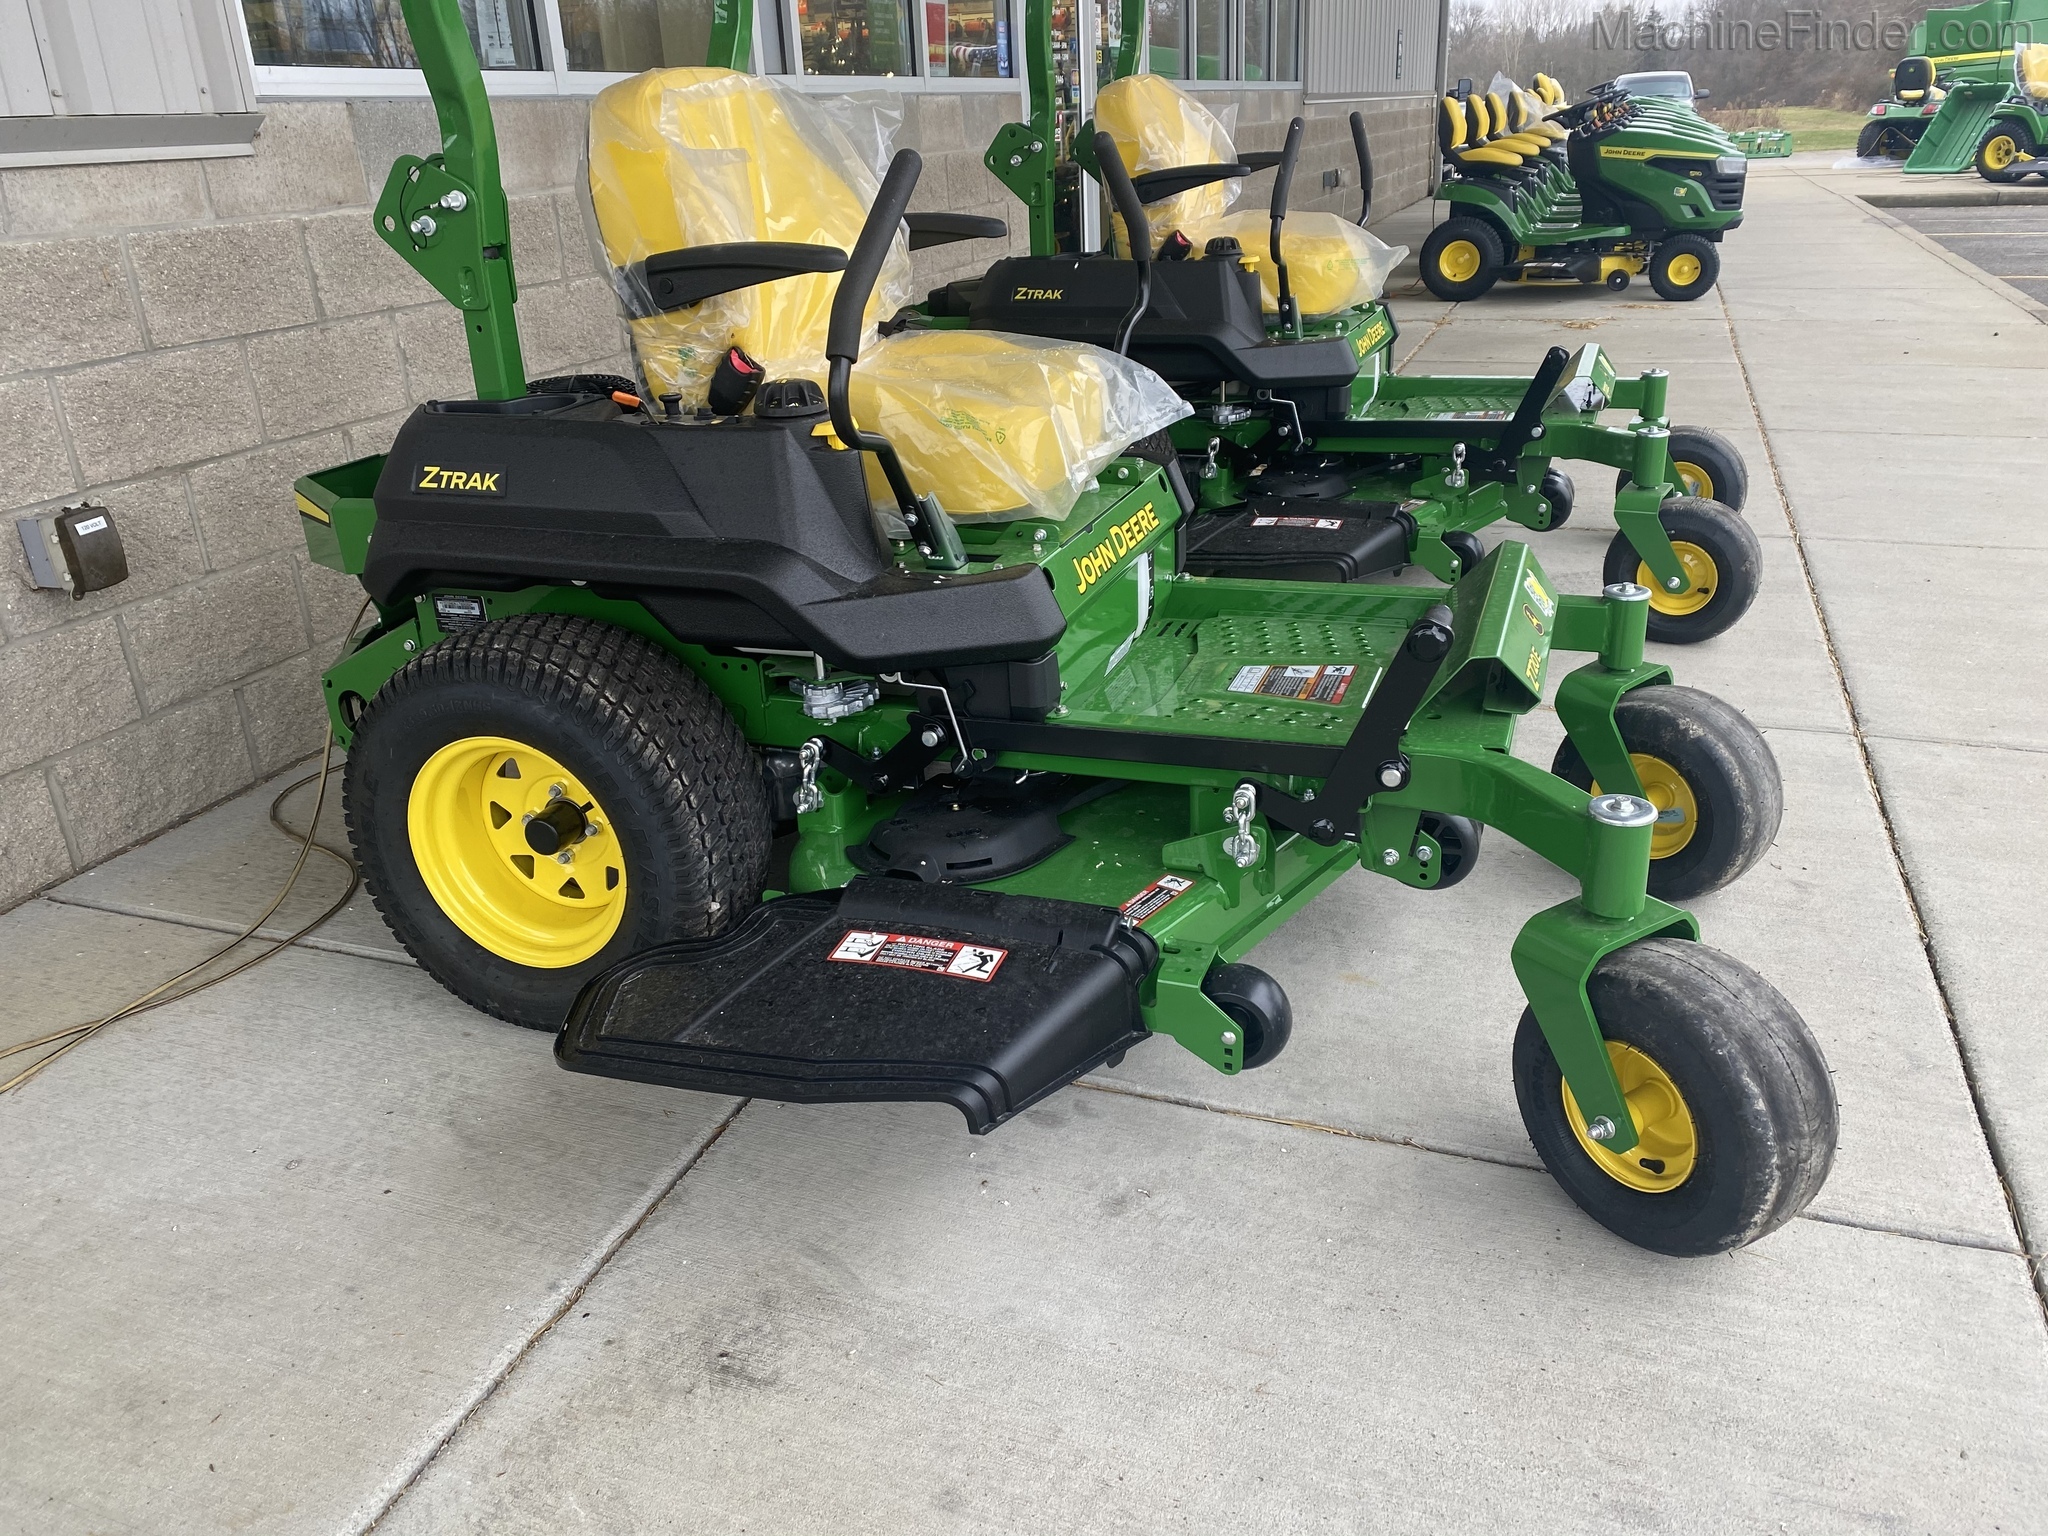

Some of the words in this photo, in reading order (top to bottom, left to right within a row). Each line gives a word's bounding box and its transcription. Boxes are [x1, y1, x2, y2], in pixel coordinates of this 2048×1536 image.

[1623, 149, 1646, 157] DEERE
[1014, 287, 1064, 300] ZTRAK
[419, 466, 500, 491] ZTRAK
[1072, 537, 1118, 595] JOHN
[1109, 501, 1161, 559] DEERE
[908, 936, 955, 949] DANGER
